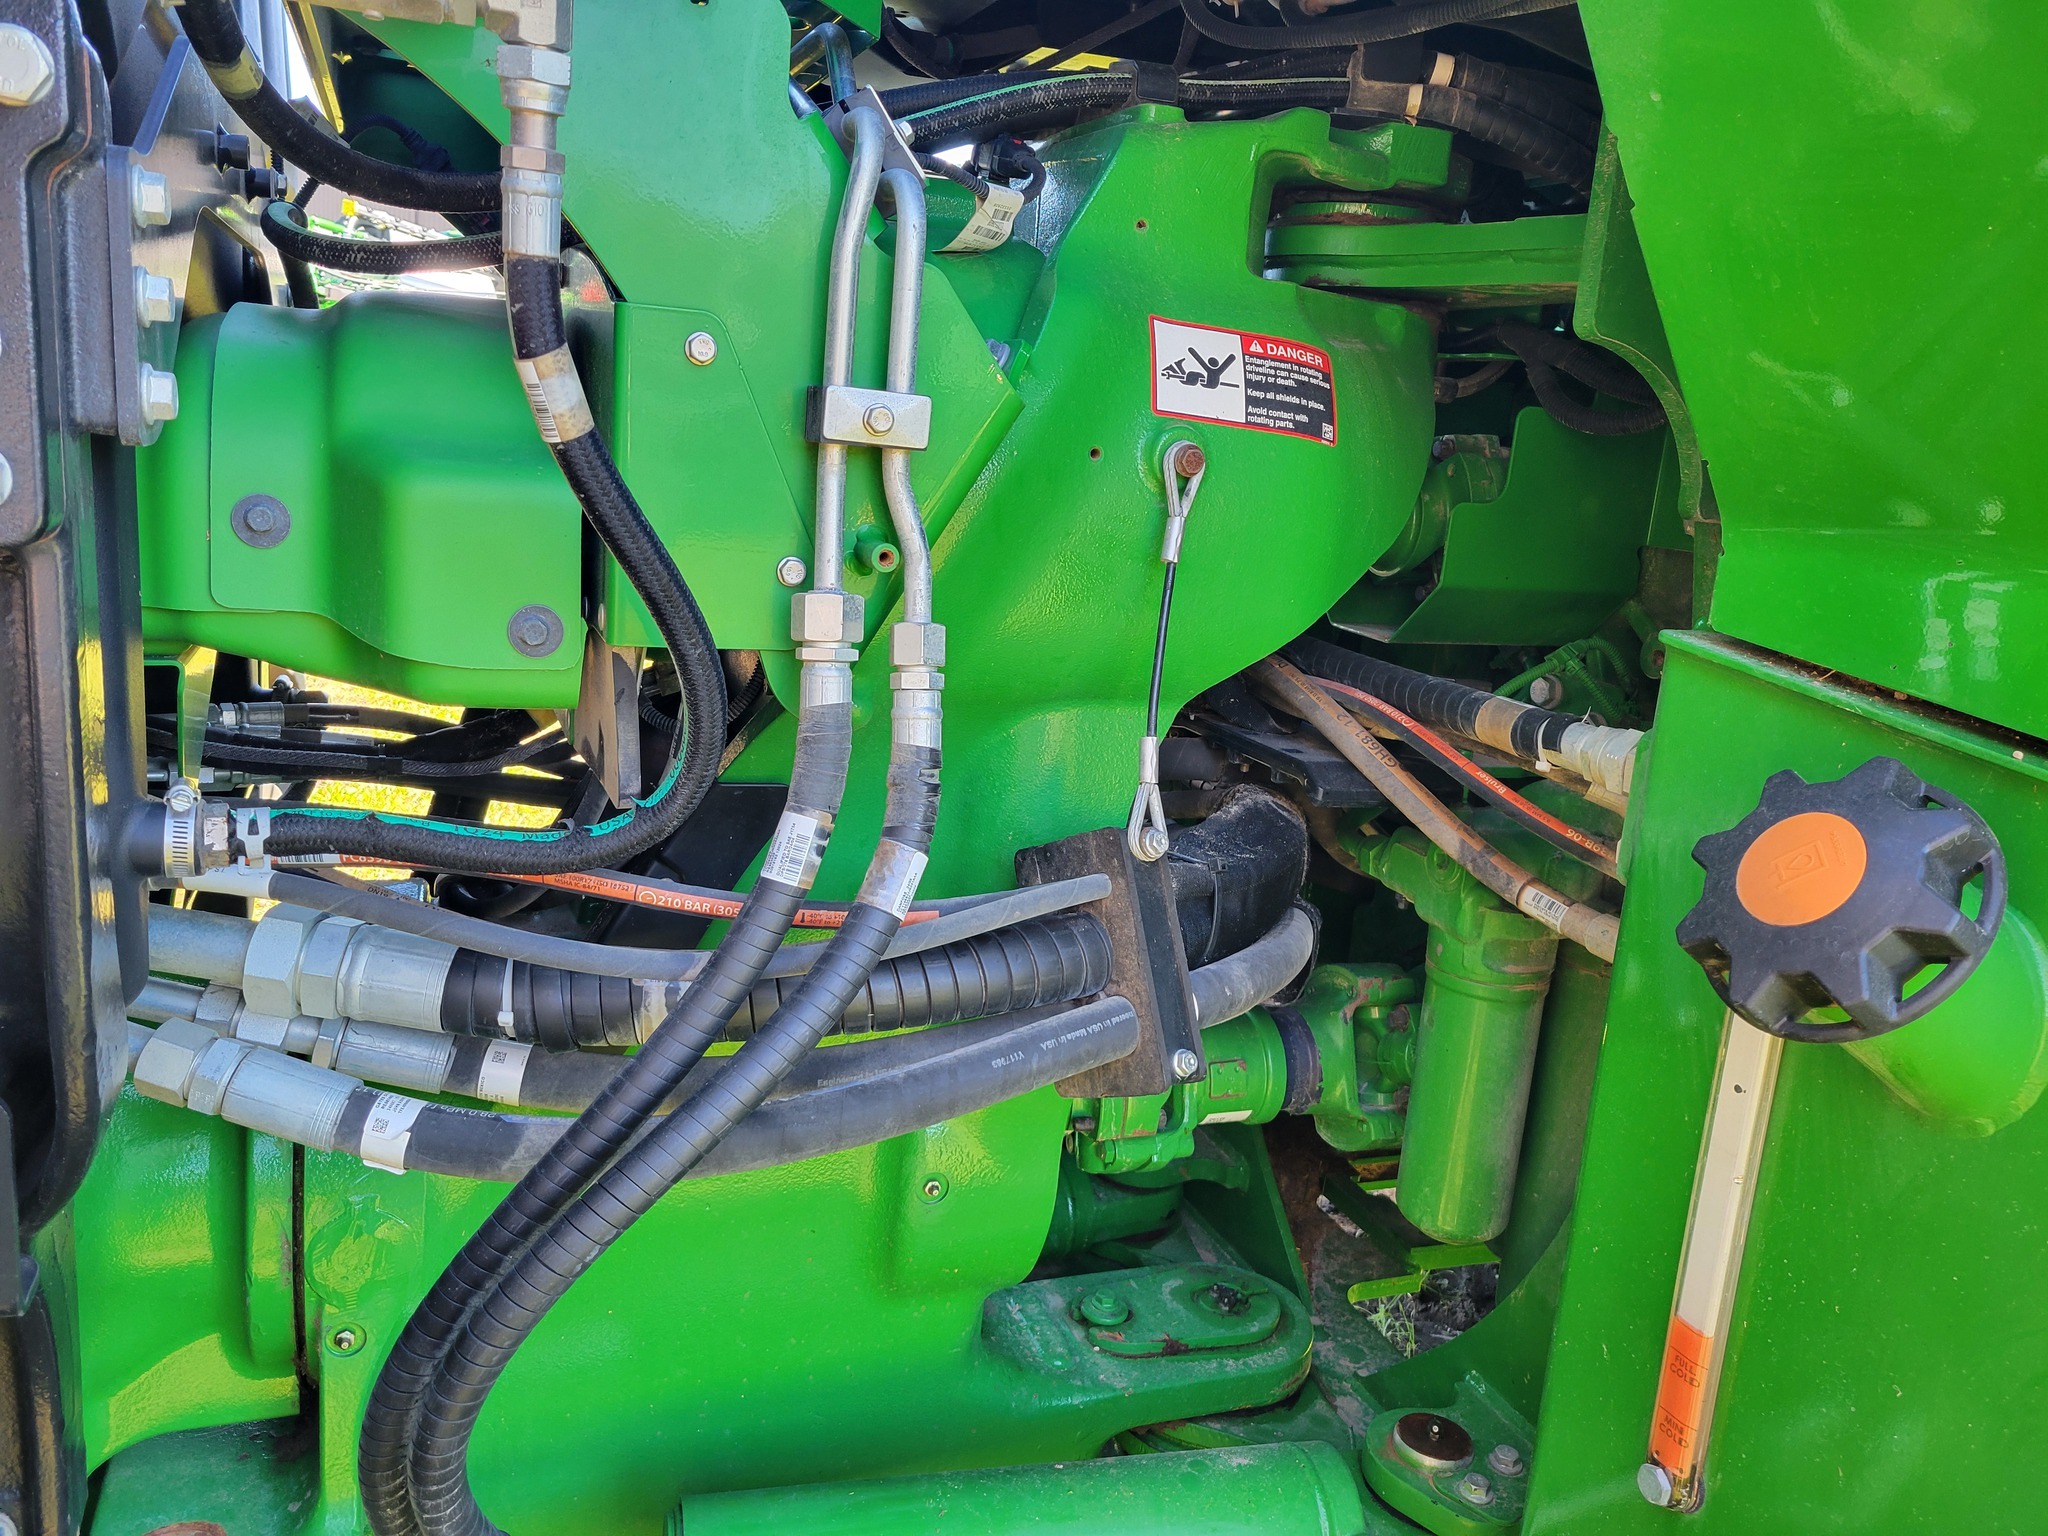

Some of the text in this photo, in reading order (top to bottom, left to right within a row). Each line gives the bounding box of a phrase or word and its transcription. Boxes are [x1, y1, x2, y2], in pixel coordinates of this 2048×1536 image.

[1266, 343, 1323, 368] DANGER
[1244, 355, 1292, 370] Entanglement
[1300, 367, 1322, 380] rotating
[1245, 364, 1275, 375] driveline
[1290, 373, 1309, 382] cause
[1310, 377, 1330, 389] serious
[1246, 372, 1266, 383] injury
[1276, 377, 1297, 387] death.
[1247, 388, 1265, 399] Keep
[1276, 394, 1300, 404] shields
[1308, 401, 1326, 411] place.
[1247, 405, 1308, 423] Avoid contact with
[1247, 415, 1295, 429] rotating parts.
[1475, 770, 1506, 794] Bruiser
[598, 812, 633, 832] USA
[776, 852, 787, 876] QUALIFIED
[553, 877, 573, 886] MSHA
[609, 882, 629, 892] 18752
[657, 895, 682, 910] 210
[684, 900, 710, 913] BAR
[1085, 1021, 1104, 1035] USA
[1101, 1019, 1111, 1029] in
[1057, 1034, 1067, 1045] in
[1065, 1027, 1087, 1042] Made
[1039, 1037, 1058, 1051] USA
[1675, 1355, 1696, 1376] FULL
[1664, 1415, 1684, 1435] MIN
